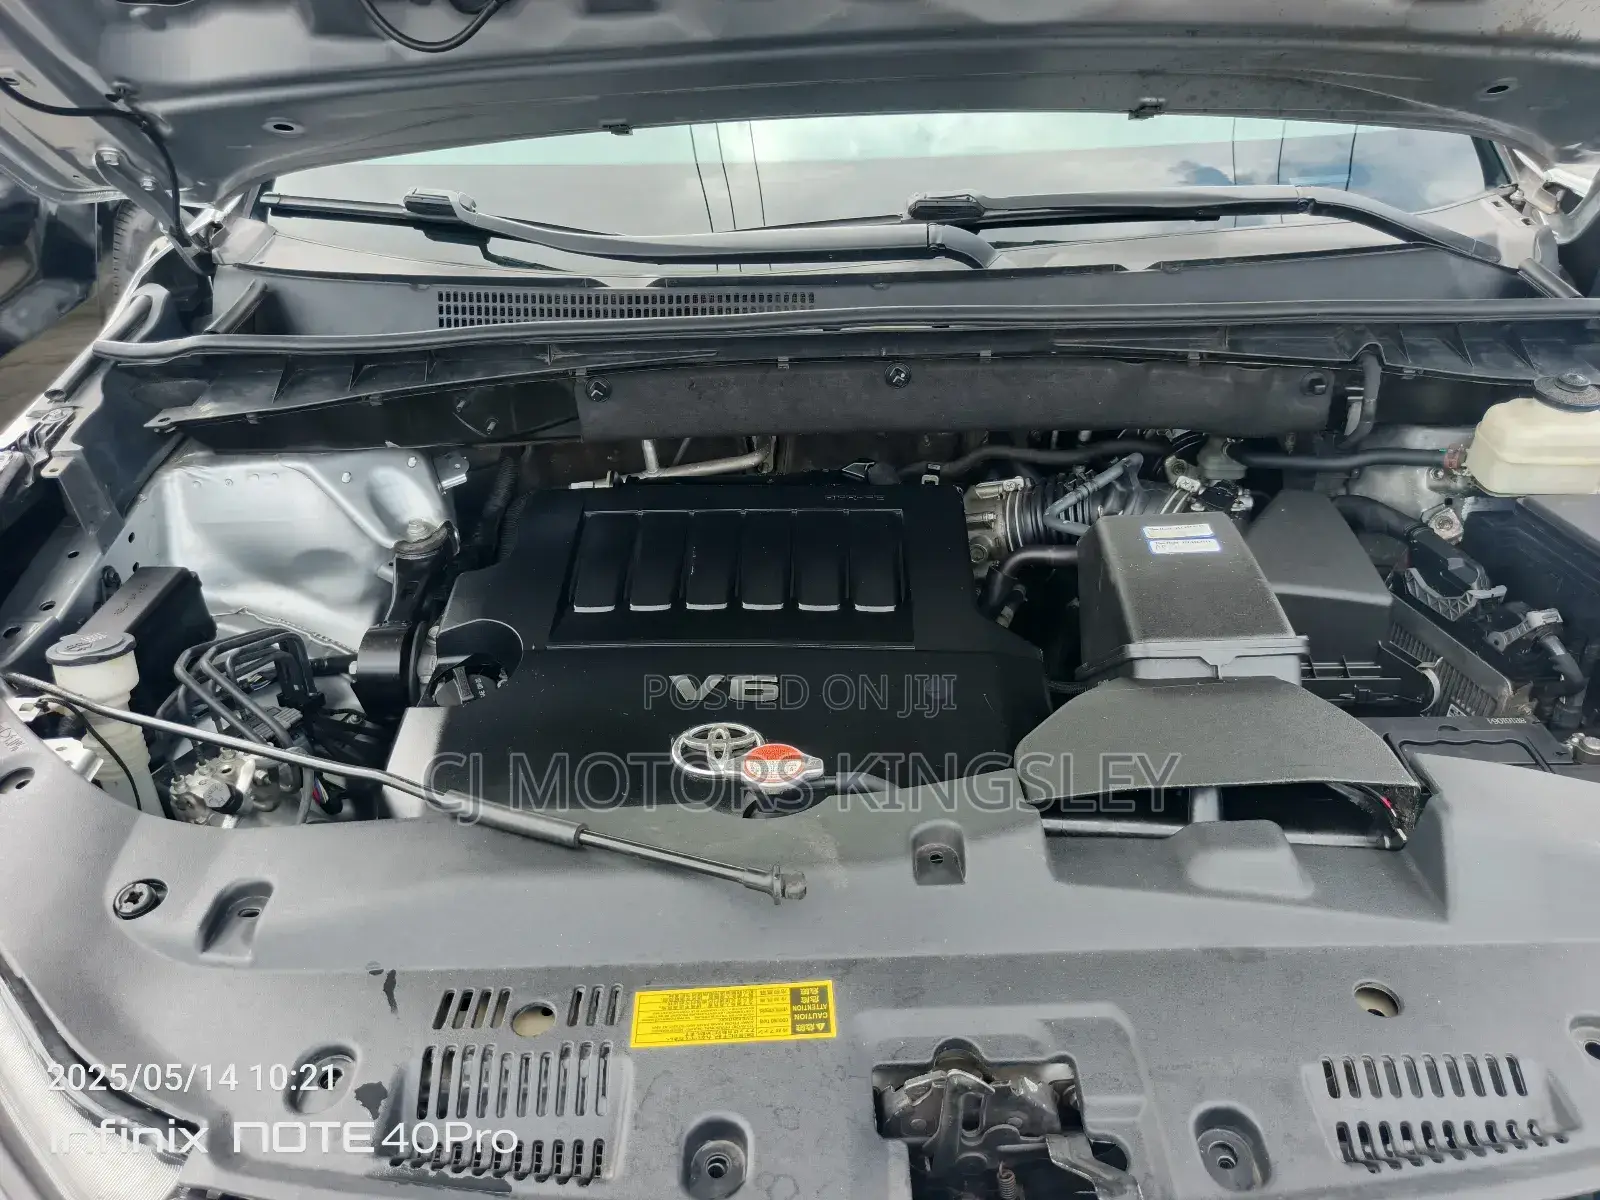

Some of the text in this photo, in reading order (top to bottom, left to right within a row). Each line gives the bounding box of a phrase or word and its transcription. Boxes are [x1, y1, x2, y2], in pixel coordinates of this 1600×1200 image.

[669, 674, 780, 702] V6
[792, 1003, 828, 1011] ATTENTION
[793, 1011, 828, 1020] CAUTION
